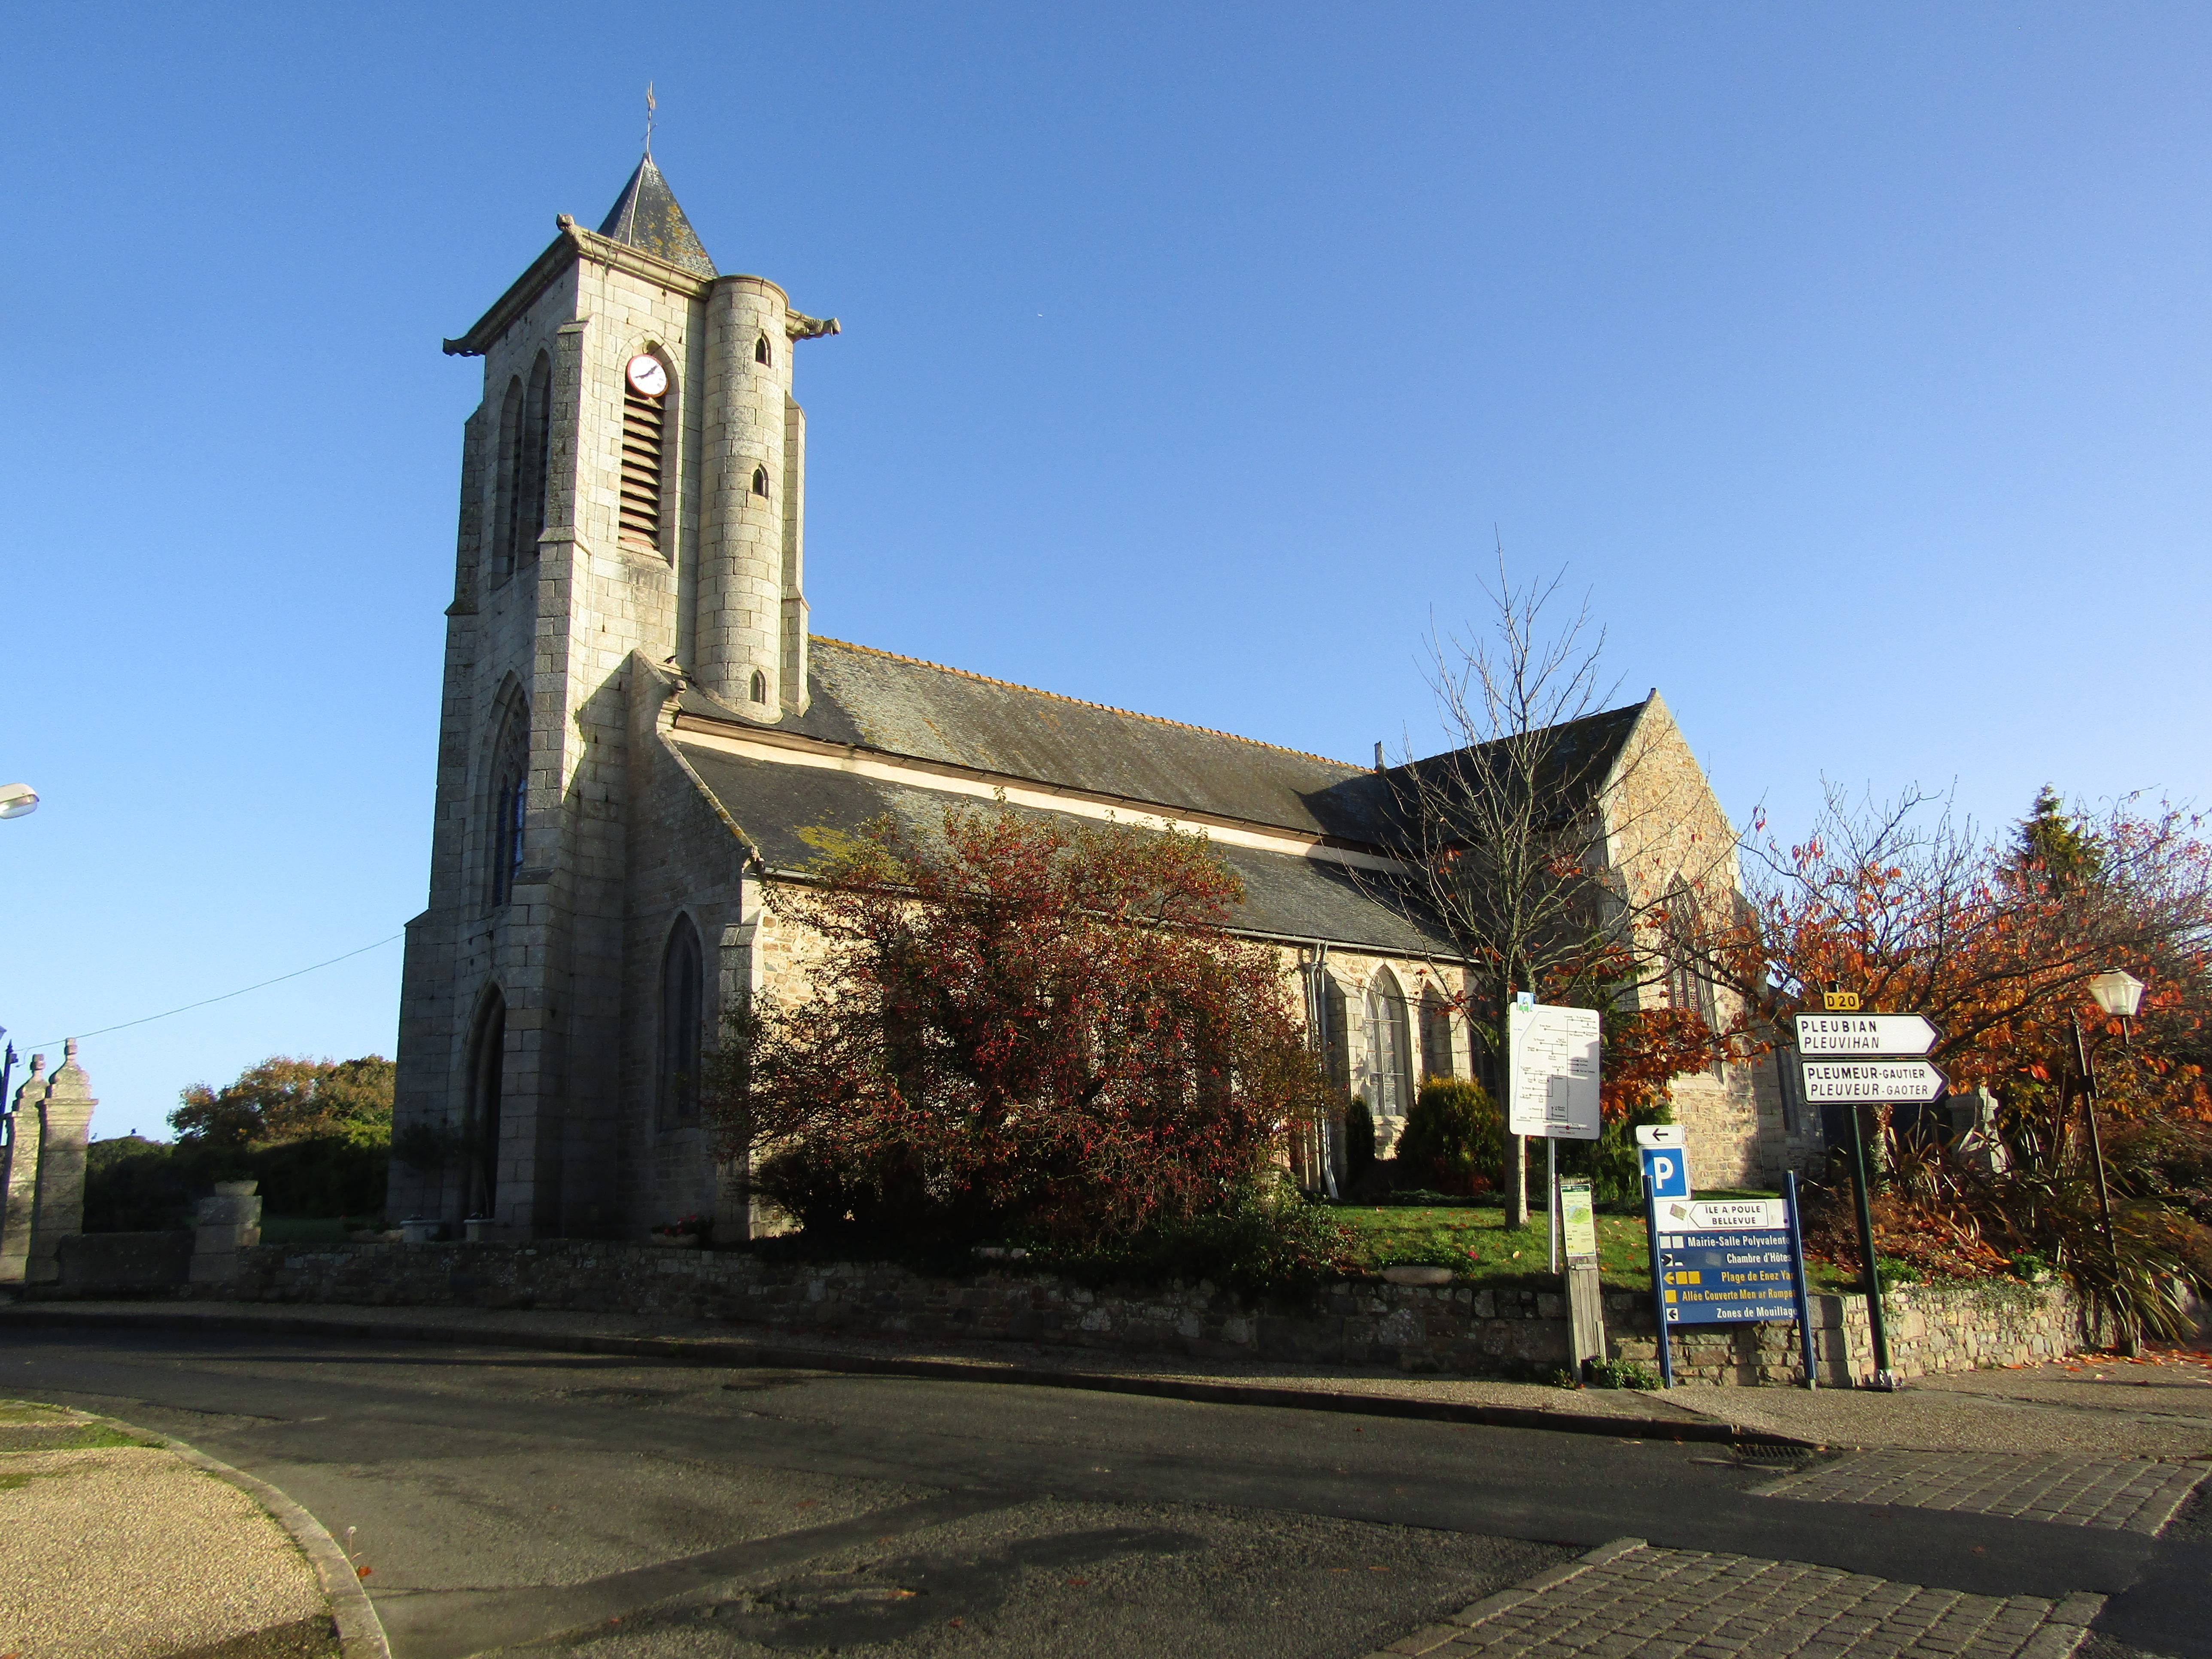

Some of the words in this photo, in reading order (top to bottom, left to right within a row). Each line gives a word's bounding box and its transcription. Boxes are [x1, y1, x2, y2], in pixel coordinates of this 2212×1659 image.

[1826, 996, 1835, 1007] D
[1838, 995, 1856, 1007] 20
[1801, 1021, 1877, 1032] PLEUBIAN
[1804, 1037, 1879, 1048] PLEUVIHAN
[1808, 1067, 1925, 1079] PLEUMEUR-GAUTIER
[1653, 1157, 1674, 1189] P
[1705, 1205, 1718, 1214] ÎLE
[1732, 1205, 1760, 1213] POULE
[1687, 1235, 1740, 1247] Mairie-Salle
[1742, 1235, 1790, 1247] Polyvalente
[1726, 1252, 1761, 1264] Chambre
[1763, 1252, 1792, 1263] d'Hôtes
[1721, 1271, 1745, 1283] Plage
[1747, 1271, 1757, 1281] de
[1759, 1270, 1779, 1281] Enez
[1682, 1290, 1702, 1301] Allée
[1704, 1289, 1738, 1300] Couverte
[1739, 1288, 1756, 1299] Men
[1758, 1291, 1766, 1299] ar
[1716, 1308, 1742, 1318] Zones
[1744, 1307, 1754, 1317] de
[1756, 1306, 1798, 1319] Mouillage
